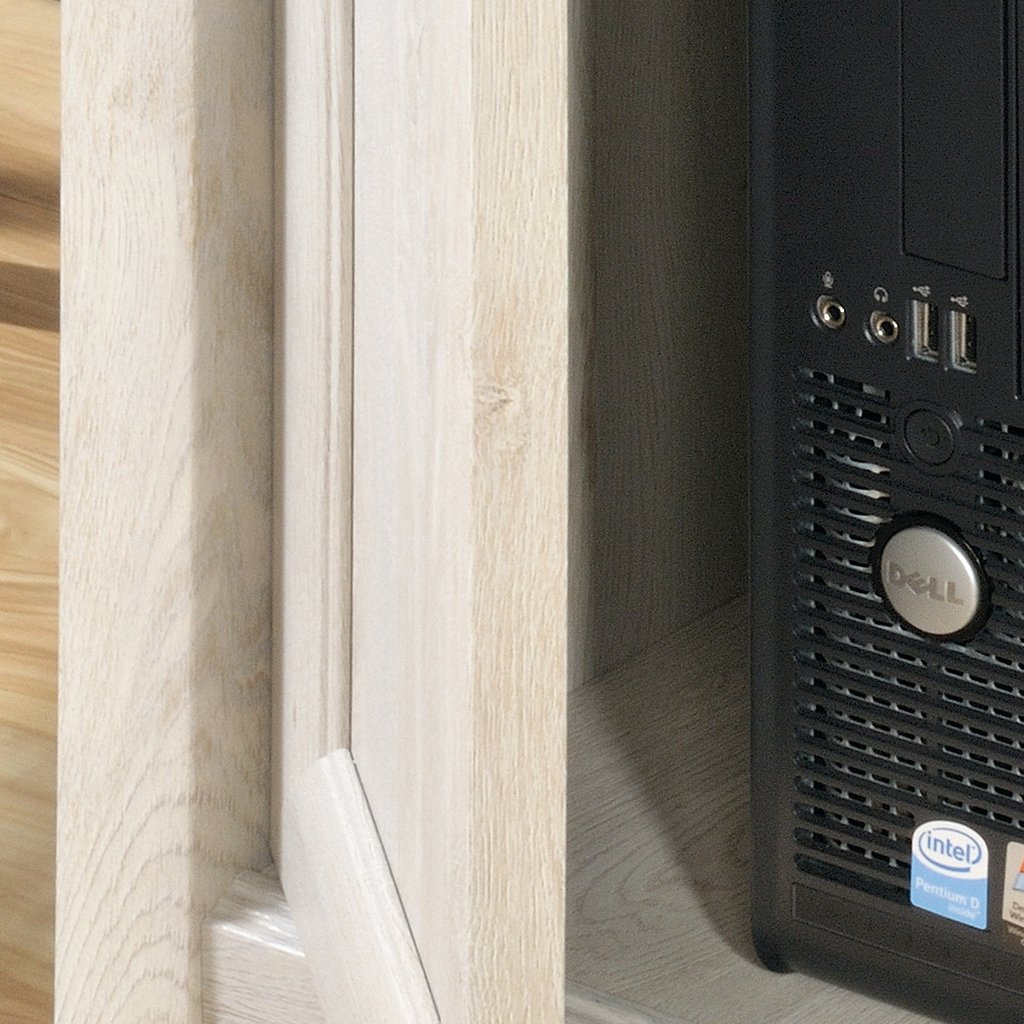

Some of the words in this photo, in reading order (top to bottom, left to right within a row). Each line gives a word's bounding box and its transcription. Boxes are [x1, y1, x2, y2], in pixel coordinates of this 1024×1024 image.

[886, 560, 964, 606] DELL
[927, 830, 971, 864] intel
[915, 876, 966, 905] Pentium
[970, 896, 980, 909] D
